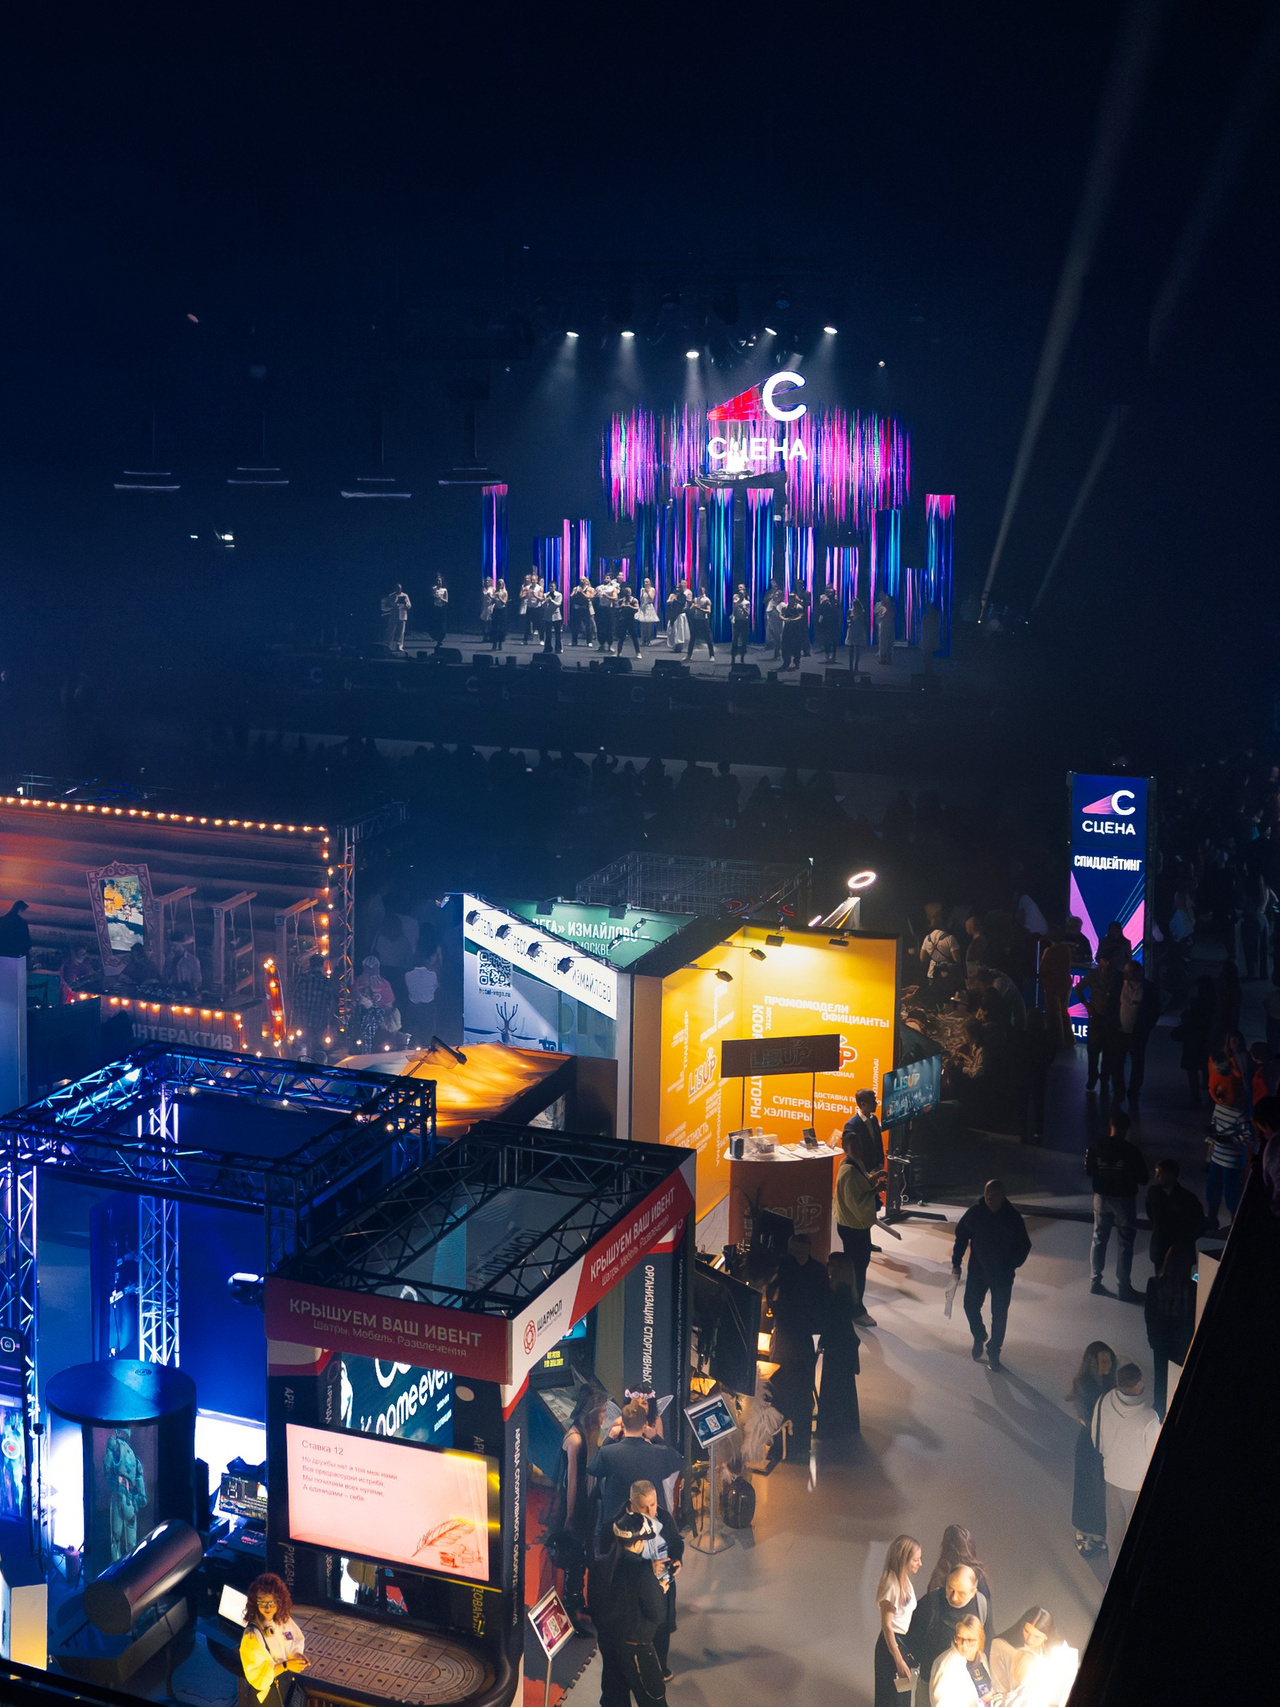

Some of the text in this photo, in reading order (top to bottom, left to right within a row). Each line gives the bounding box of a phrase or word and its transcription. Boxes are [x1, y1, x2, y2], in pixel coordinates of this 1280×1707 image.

[1081, 820, 1137, 836] СЦЕНА
[1073, 854, 1143, 872] СПИДДЕЙТИНГ
[764, 995, 850, 1015] ПРОМОМОДЕЛИ
[821, 1012, 890, 1029] ОФИЦИАНТЫ
[763, 1106, 813, 1123] ХЭЛПЕРЫ
[772, 1094, 853, 1116] СУПЕРВАЙЗЕРЫ
[589, 1187, 675, 1283] КРЫШУЕМ ВАШ ИВЕНТ
[289, 1298, 483, 1348] КРЫШУЕМ ВАШ ИВЕНТ
[642, 1264, 655, 1384] ОРГАНИЗАЦИЯ СПОРТИВНЫХ
[397, 1336, 468, 1358] Развлечения
[301, 1440, 344, 1456] Ставка 12
[514, 1427, 522, 1469] АРЕНДА
[513, 1468, 521, 1542] СПОРТИВНОГО
